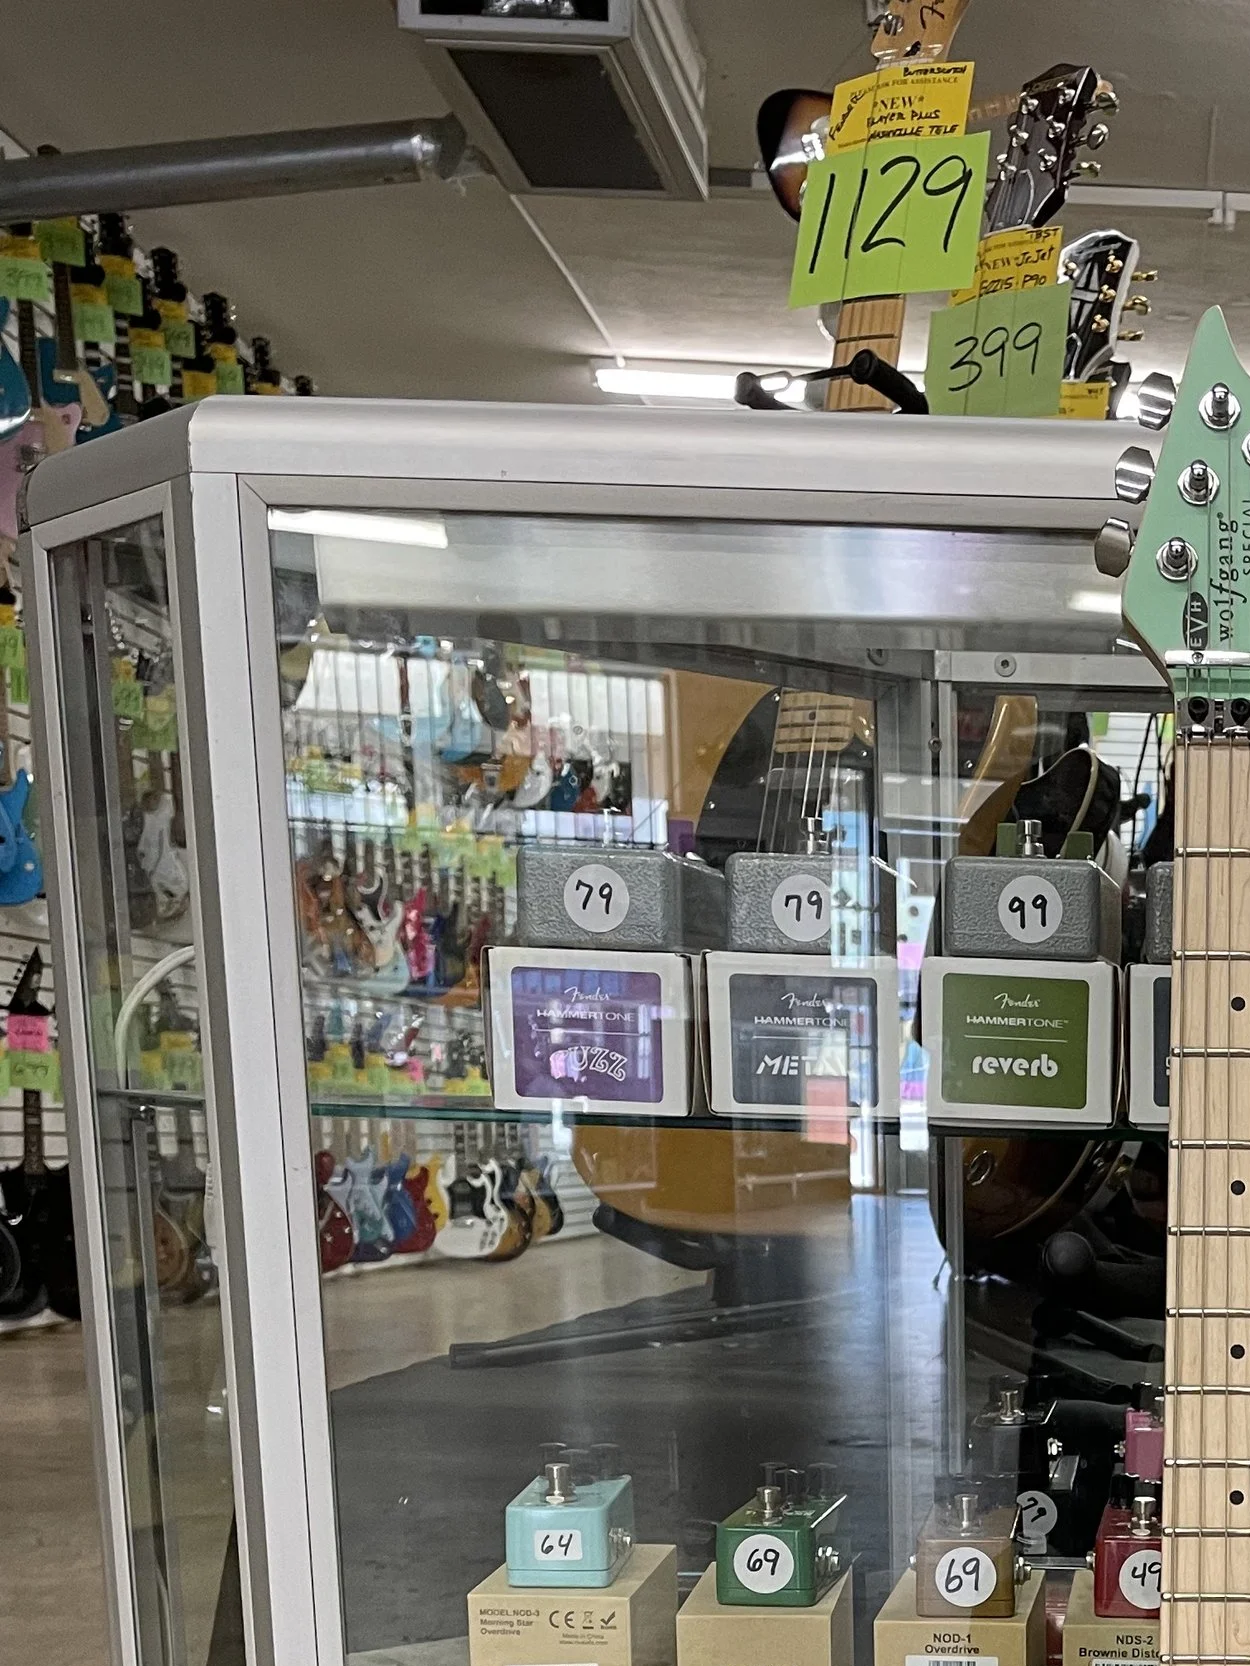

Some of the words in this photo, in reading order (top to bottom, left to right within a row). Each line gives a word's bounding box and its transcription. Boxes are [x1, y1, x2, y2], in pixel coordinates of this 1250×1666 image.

[911, 110, 941, 120] PLUS
[807, 154, 974, 275] 1129
[947, 321, 1041, 392] 399
[575, 879, 614, 915] 79
[784, 890, 823, 922] 79
[1008, 893, 1048, 930] 99
[564, 986, 611, 1003] Fender
[993, 991, 1042, 1010] Fender
[536, 1008, 636, 1023] HAMMERTONE
[971, 1053, 1060, 1079] reverb
[540, 1533, 573, 1556] 64
[746, 1548, 780, 1576] 69
[944, 1556, 981, 1594] 69
[480, 1627, 521, 1636] Overdrive
[932, 1633, 972, 1644] NOD-1
[1115, 1634, 1154, 1645] NDS-2
[924, 1644, 980, 1655] Overdrive
[1078, 1647, 1128, 1658] Brownie
